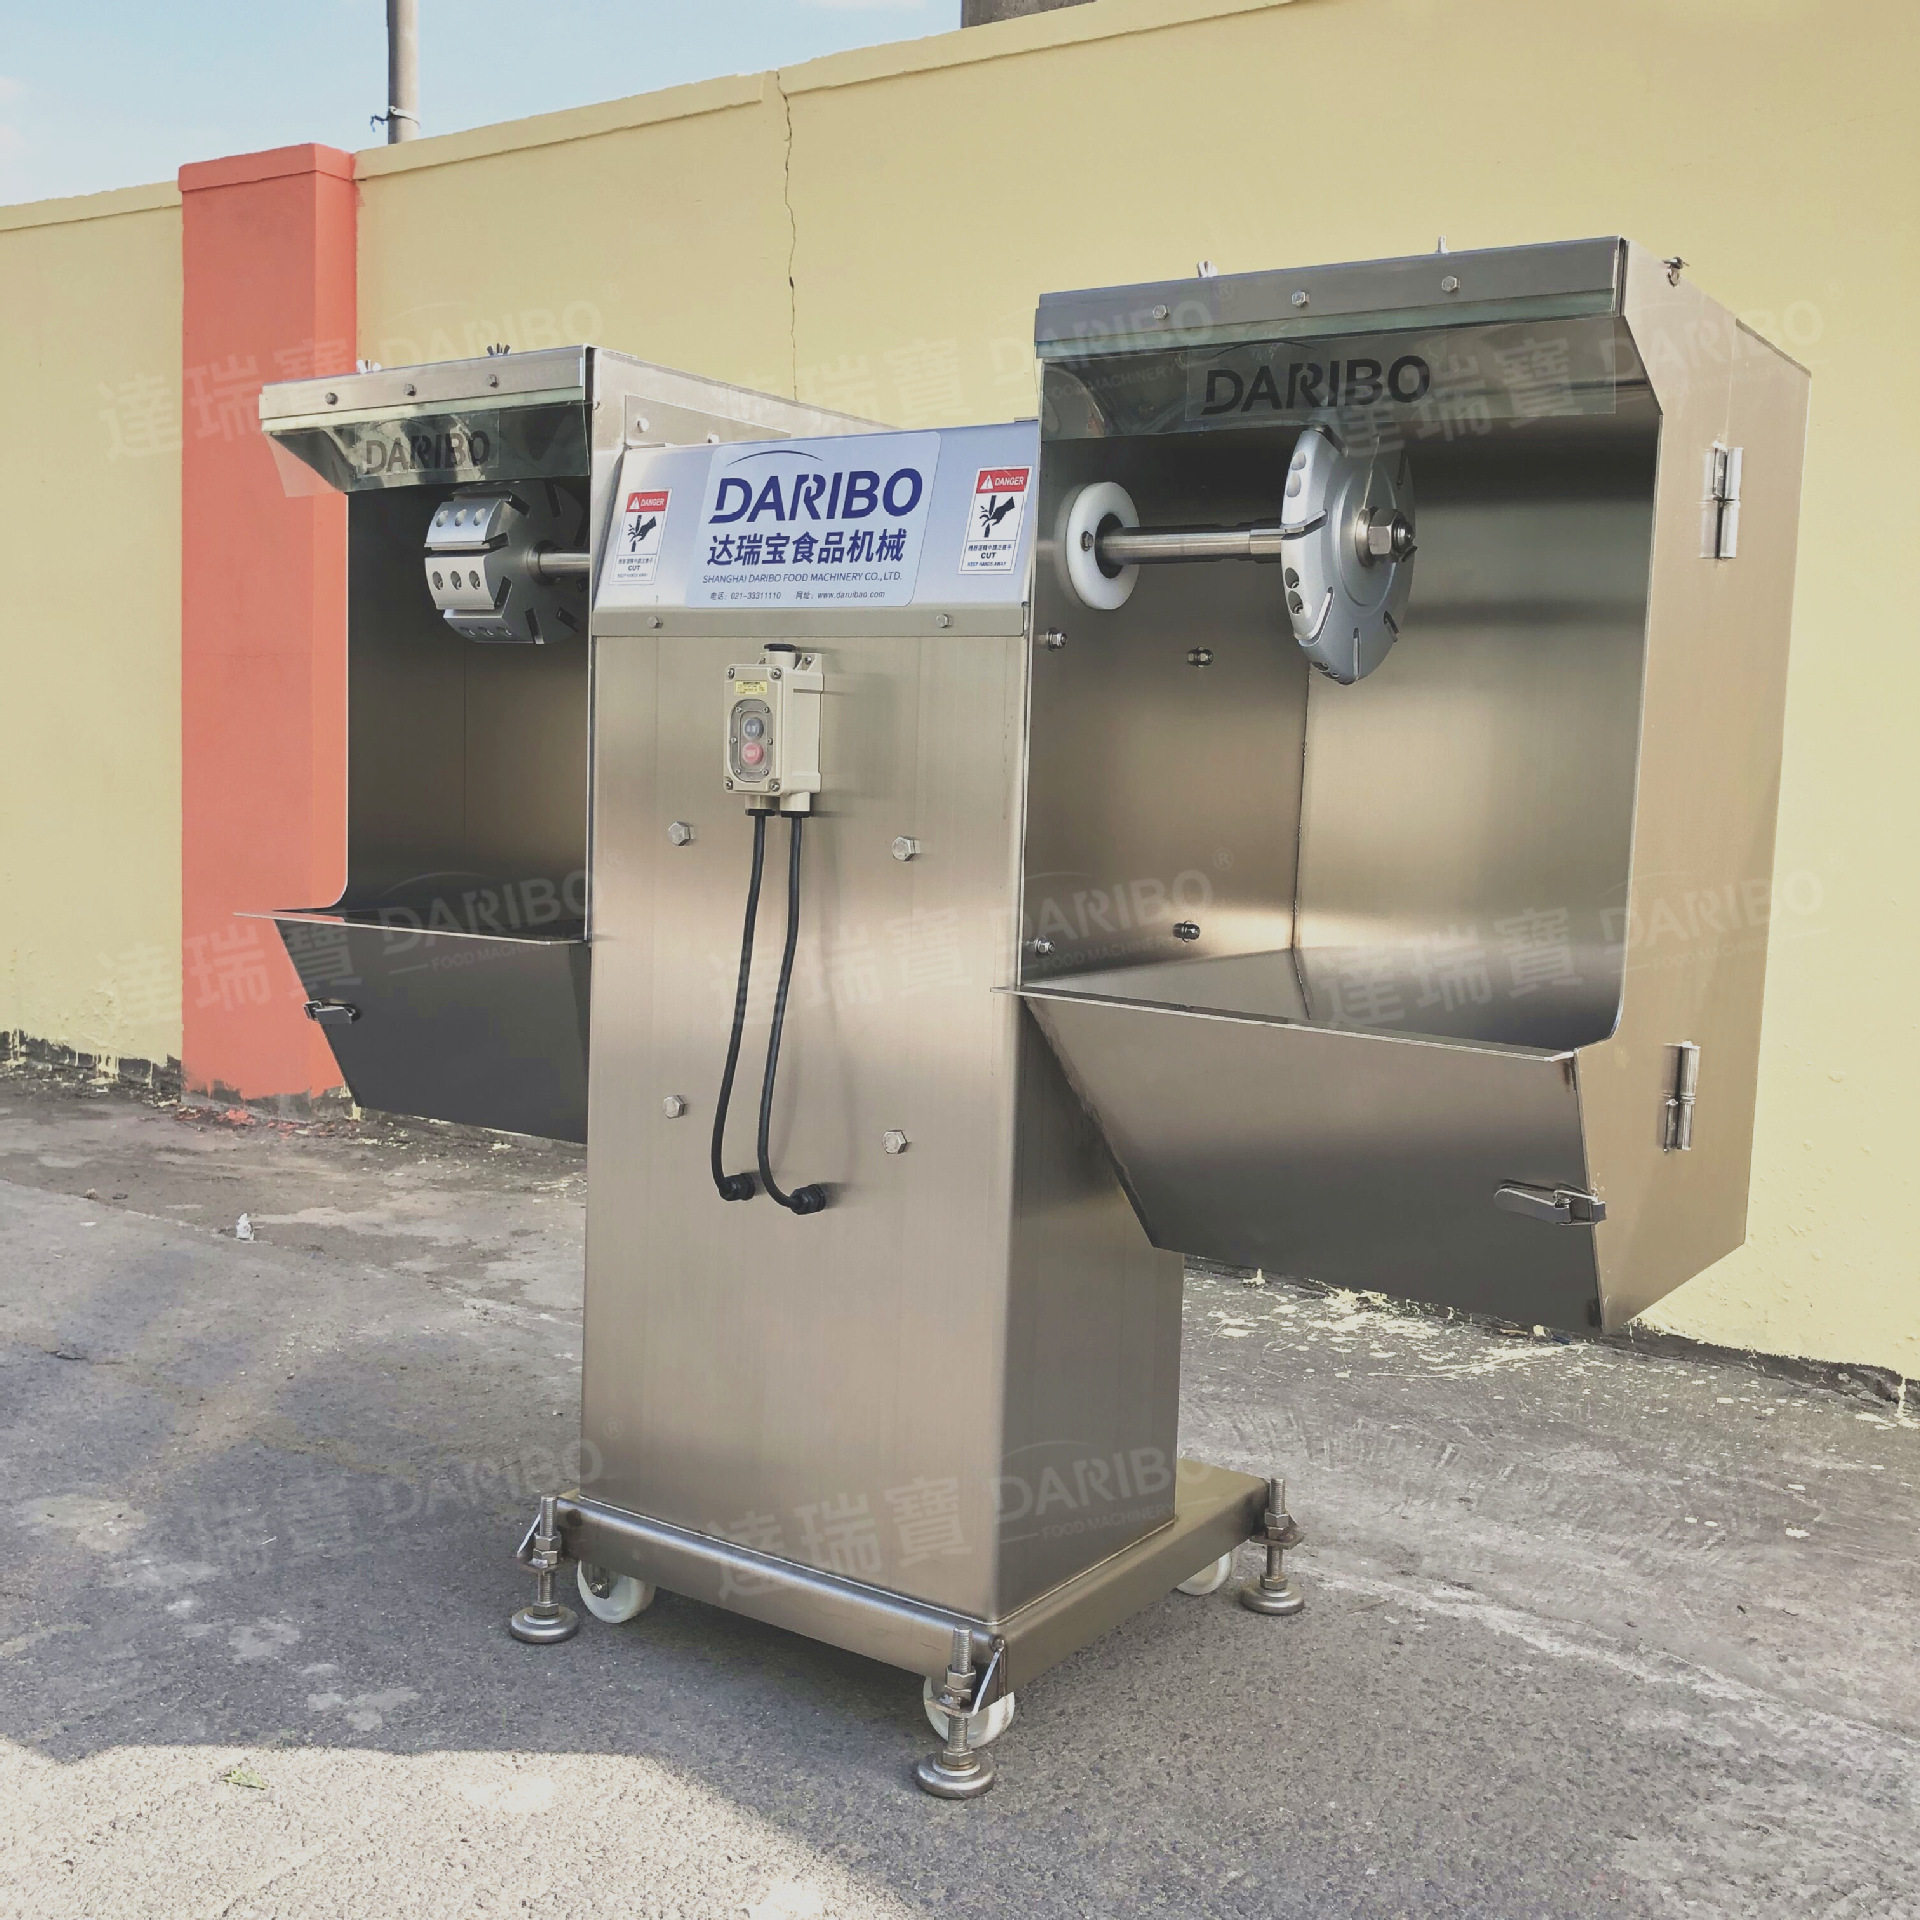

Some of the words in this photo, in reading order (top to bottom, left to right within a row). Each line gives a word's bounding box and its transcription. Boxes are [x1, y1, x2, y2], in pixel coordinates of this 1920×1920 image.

[1201, 355, 1430, 415] DARIBO
[366, 430, 490, 475] DARIBO
[708, 467, 923, 524] DARIBO
[995, 476, 1024, 486] DANGER
[707, 528, 907, 567] 达瑞宝食品机械
[702, 574, 747, 584] SHANGHAI
[748, 573, 781, 583] DARIBO
[782, 573, 808, 582] FOOD
[810, 572, 863, 582] MACHINERY
